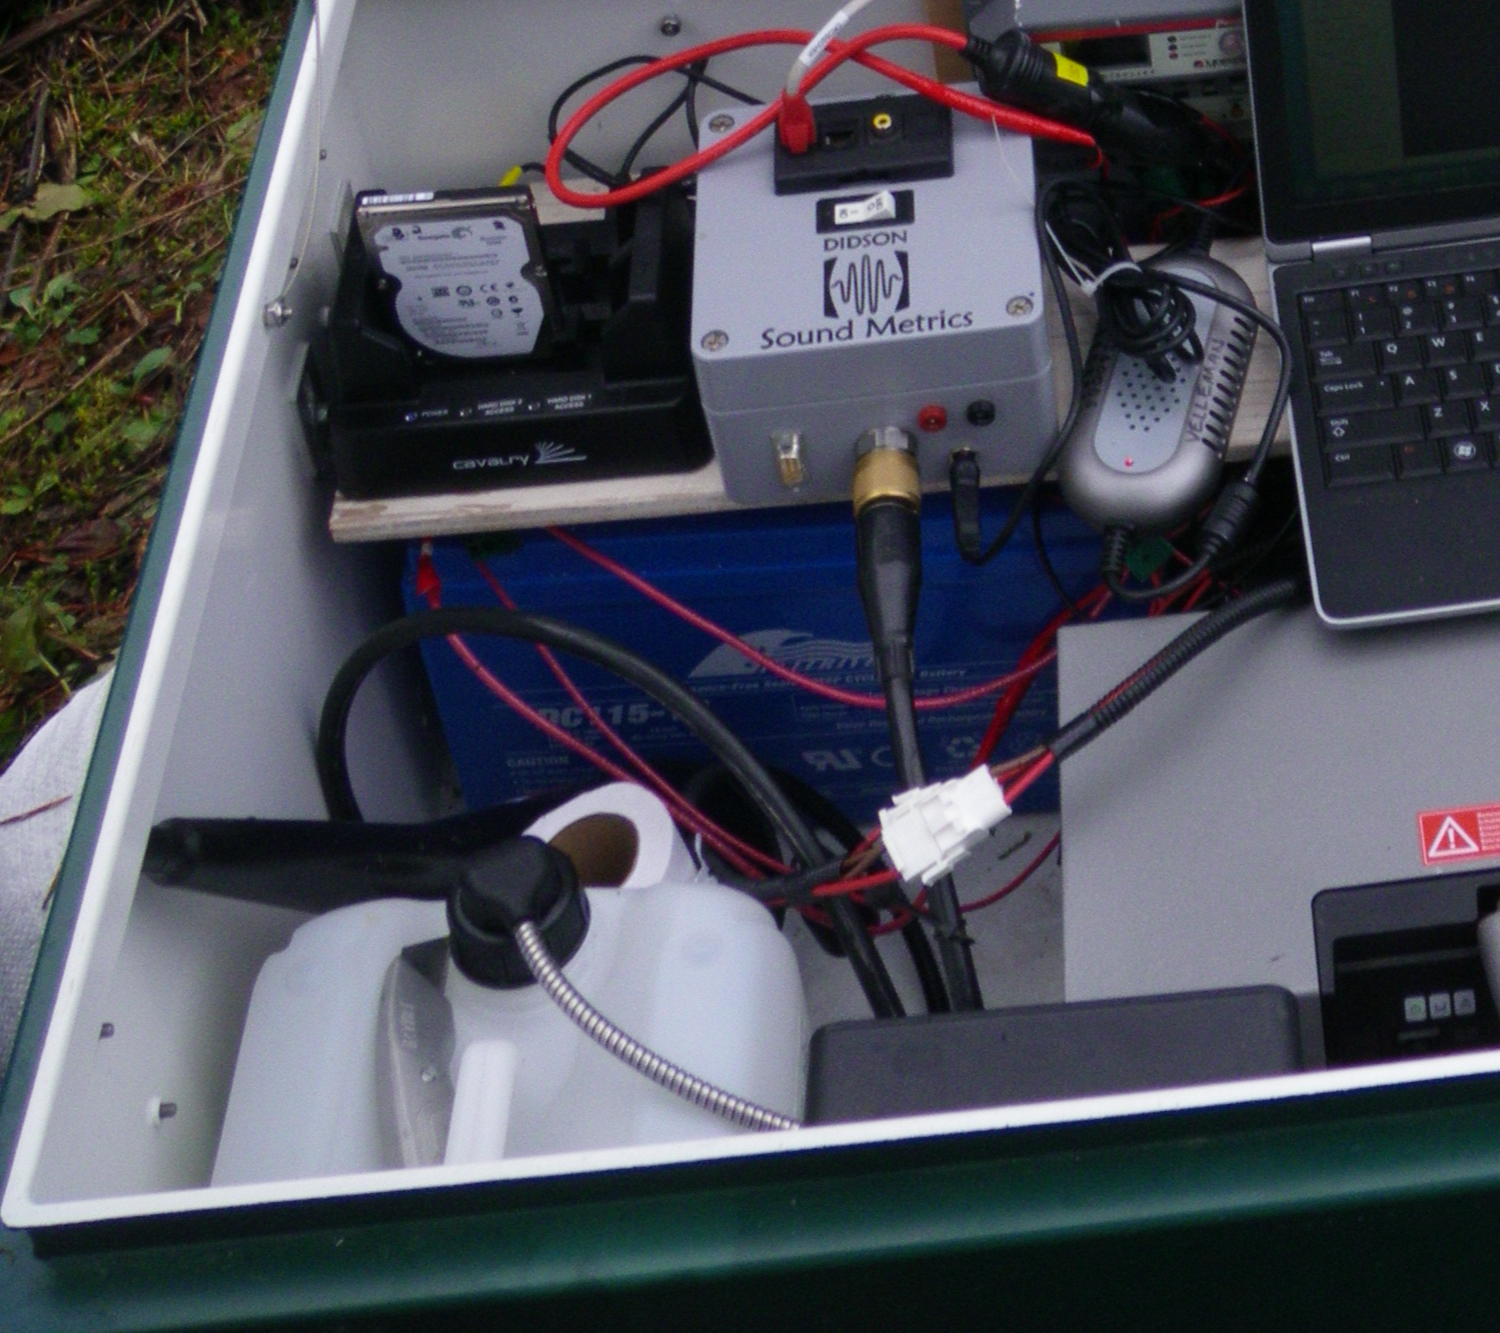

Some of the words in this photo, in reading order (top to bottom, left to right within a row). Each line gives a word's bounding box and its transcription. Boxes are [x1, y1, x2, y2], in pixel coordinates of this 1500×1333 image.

[823, 230, 908, 252] DIDSON
[760, 319, 854, 350] Sound
[866, 310, 973, 339] Metrics
[1475, 331, 1484, 342] E
[1431, 337, 1446, 348] W
[1386, 342, 1399, 355] Q
[1405, 375, 1415, 385] A
[1450, 369, 1458, 380] S
[1186, 338, 1226, 443] VELLEMAN
[1480, 400, 1490, 412] X
[1434, 407, 1443, 418] Z
